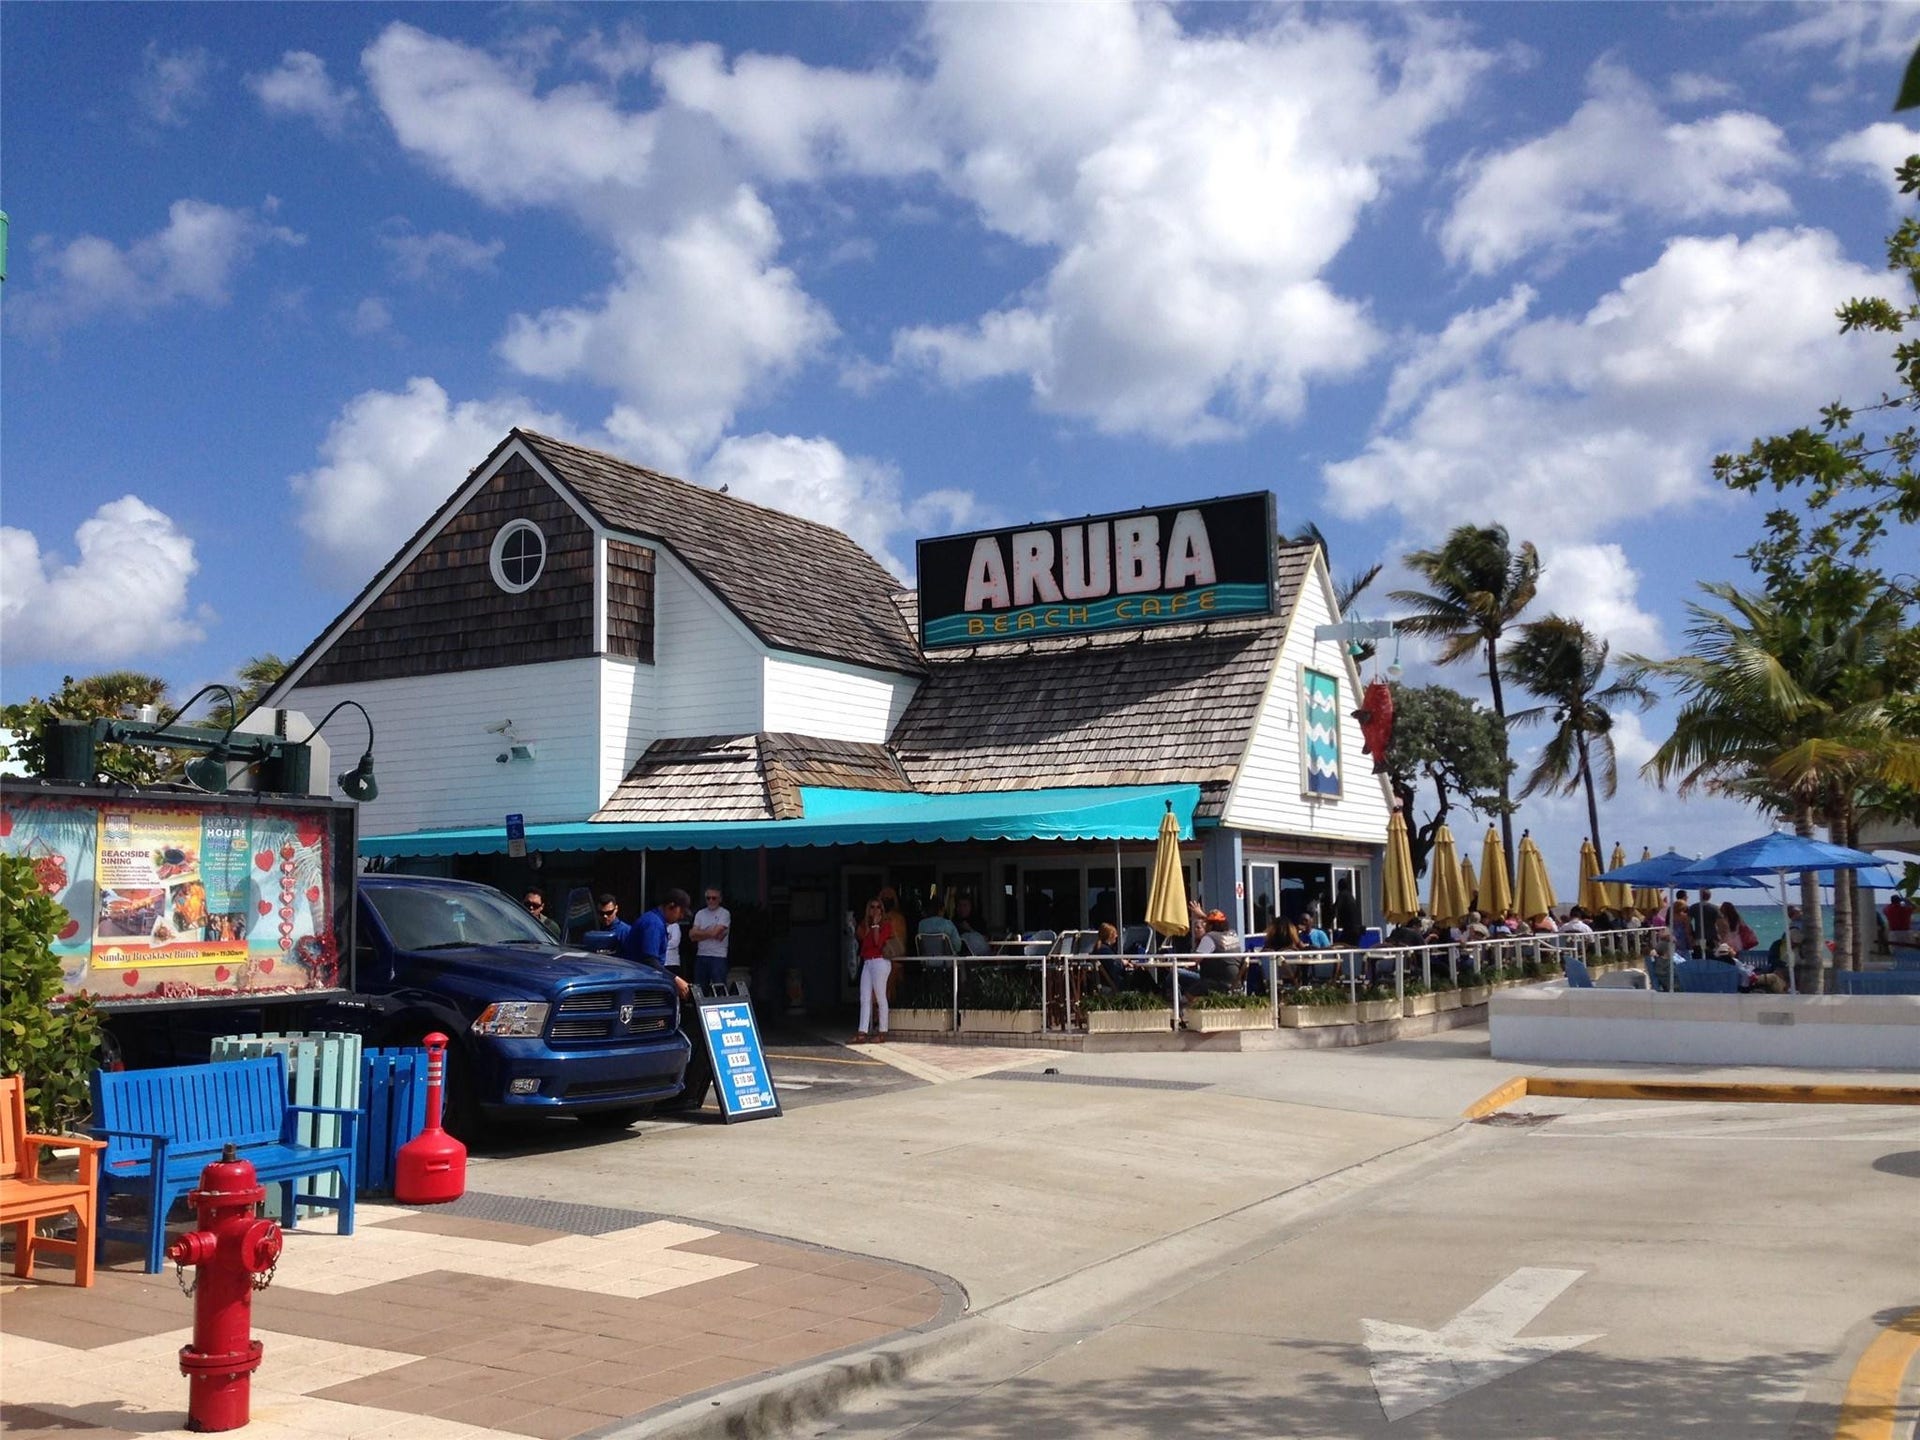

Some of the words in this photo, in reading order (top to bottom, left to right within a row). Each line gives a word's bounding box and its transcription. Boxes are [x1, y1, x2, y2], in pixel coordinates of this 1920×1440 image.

[964, 509, 1217, 612] ARUBA
[968, 604, 1090, 635] BEACH
[1116, 591, 1217, 619] CAFE
[207, 818, 246, 827] HAPPY
[207, 828, 246, 838] HOUR!
[101, 850, 150, 858] BEACHSIDE
[99, 952, 131, 962] Sunday
[133, 951, 172, 961] Breakfast
[174, 950, 200, 960] Buffet
